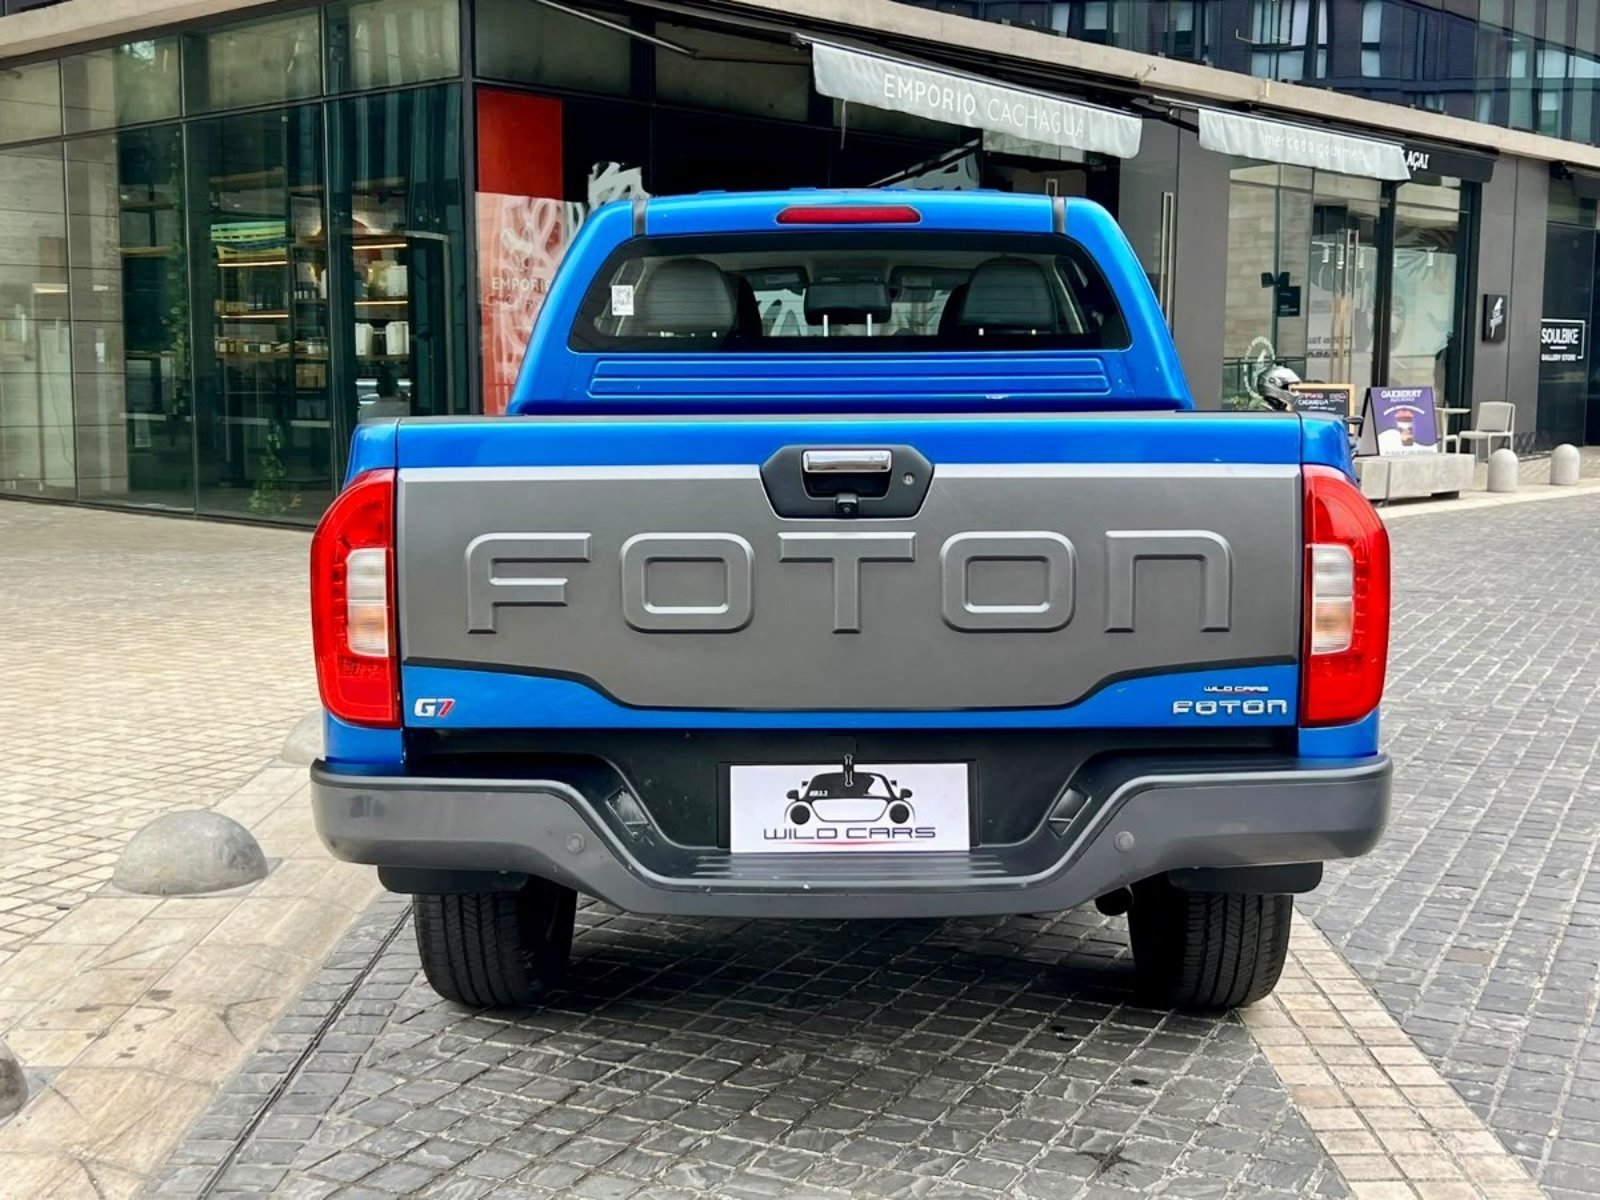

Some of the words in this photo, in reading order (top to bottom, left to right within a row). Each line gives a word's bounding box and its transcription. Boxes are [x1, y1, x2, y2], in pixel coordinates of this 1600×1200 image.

[884, 73, 976, 117] EMPORIO
[987, 99, 1084, 139] CACHAGUA
[464, 530, 1234, 635] FOTON
[414, 698, 456, 718] G7
[1172, 699, 1288, 715] FOTON
[763, 827, 838, 840] WILD
[845, 826, 936, 839] CARS
